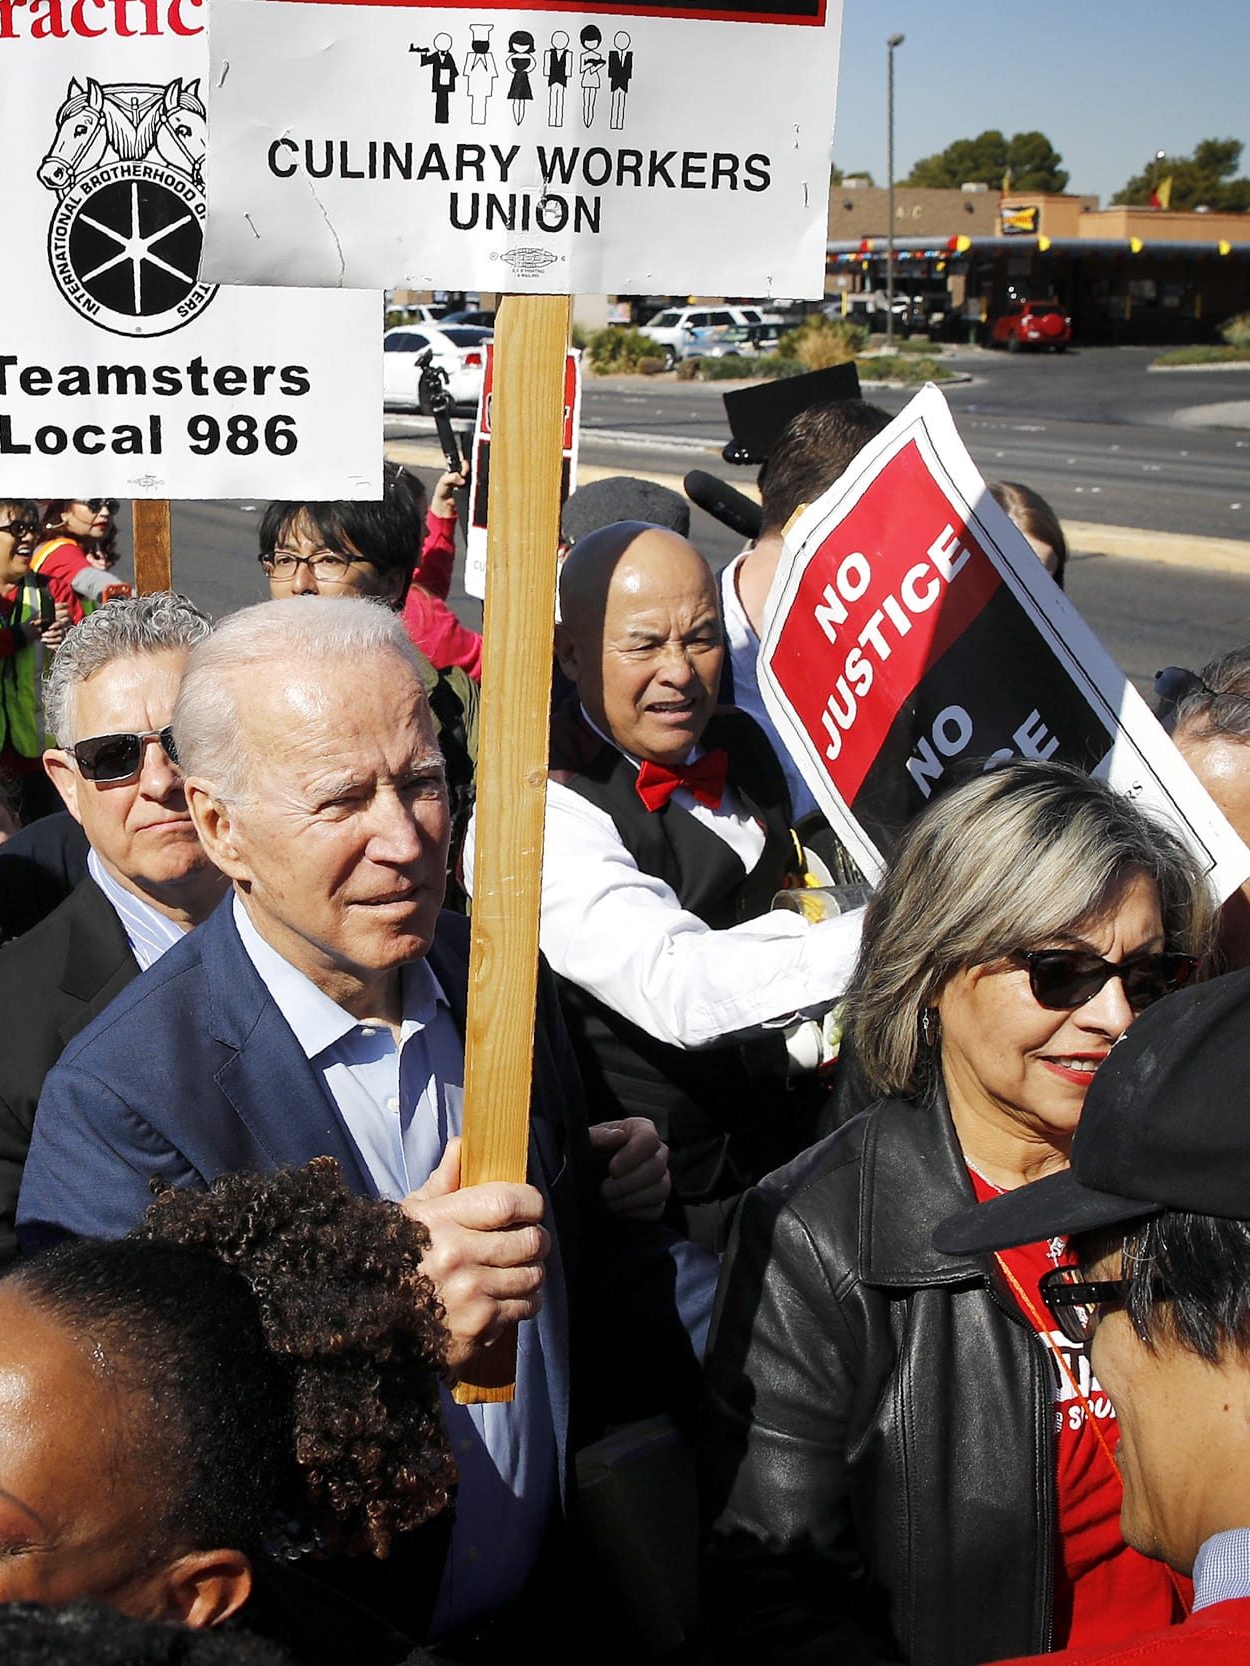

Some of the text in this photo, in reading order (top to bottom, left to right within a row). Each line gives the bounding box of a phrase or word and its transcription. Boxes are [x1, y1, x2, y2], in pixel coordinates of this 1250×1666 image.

[267, 137, 771, 193] CULINARY WORKERS
[54, 195, 102, 316] INTERNATIONAL
[79, 164, 197, 202] BROTHERHOOD
[449, 191, 601, 234] UNION
[187, 414, 298, 457] 986
[813, 551, 872, 645] NO
[821, 523, 972, 762] JUSTICE
[905, 705, 974, 800] NO
